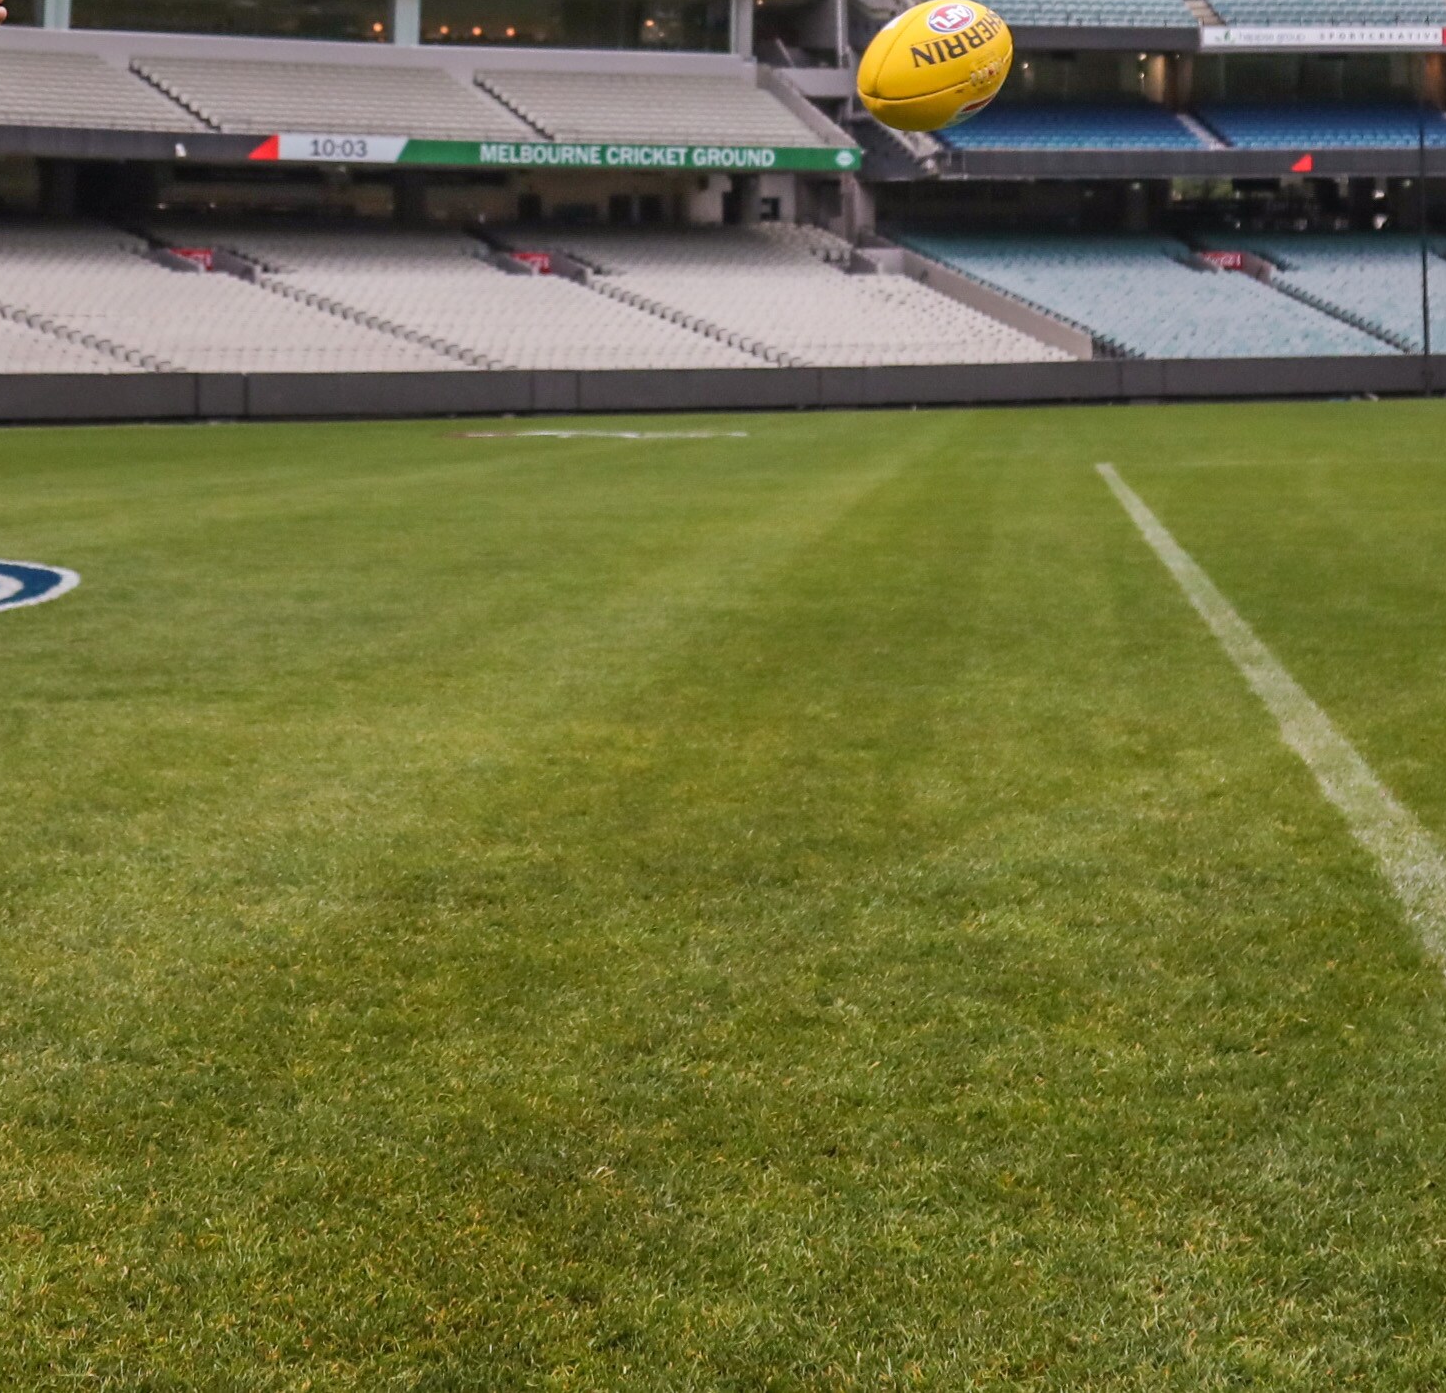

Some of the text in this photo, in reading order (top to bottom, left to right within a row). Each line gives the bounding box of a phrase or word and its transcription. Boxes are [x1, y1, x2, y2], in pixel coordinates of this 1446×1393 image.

[929, 5, 970, 29] AFL
[909, 9, 1004, 68] SHERRIN
[309, 138, 368, 159] 10:03
[479, 142, 776, 168] MELBOURNE CRICKET GROUND
